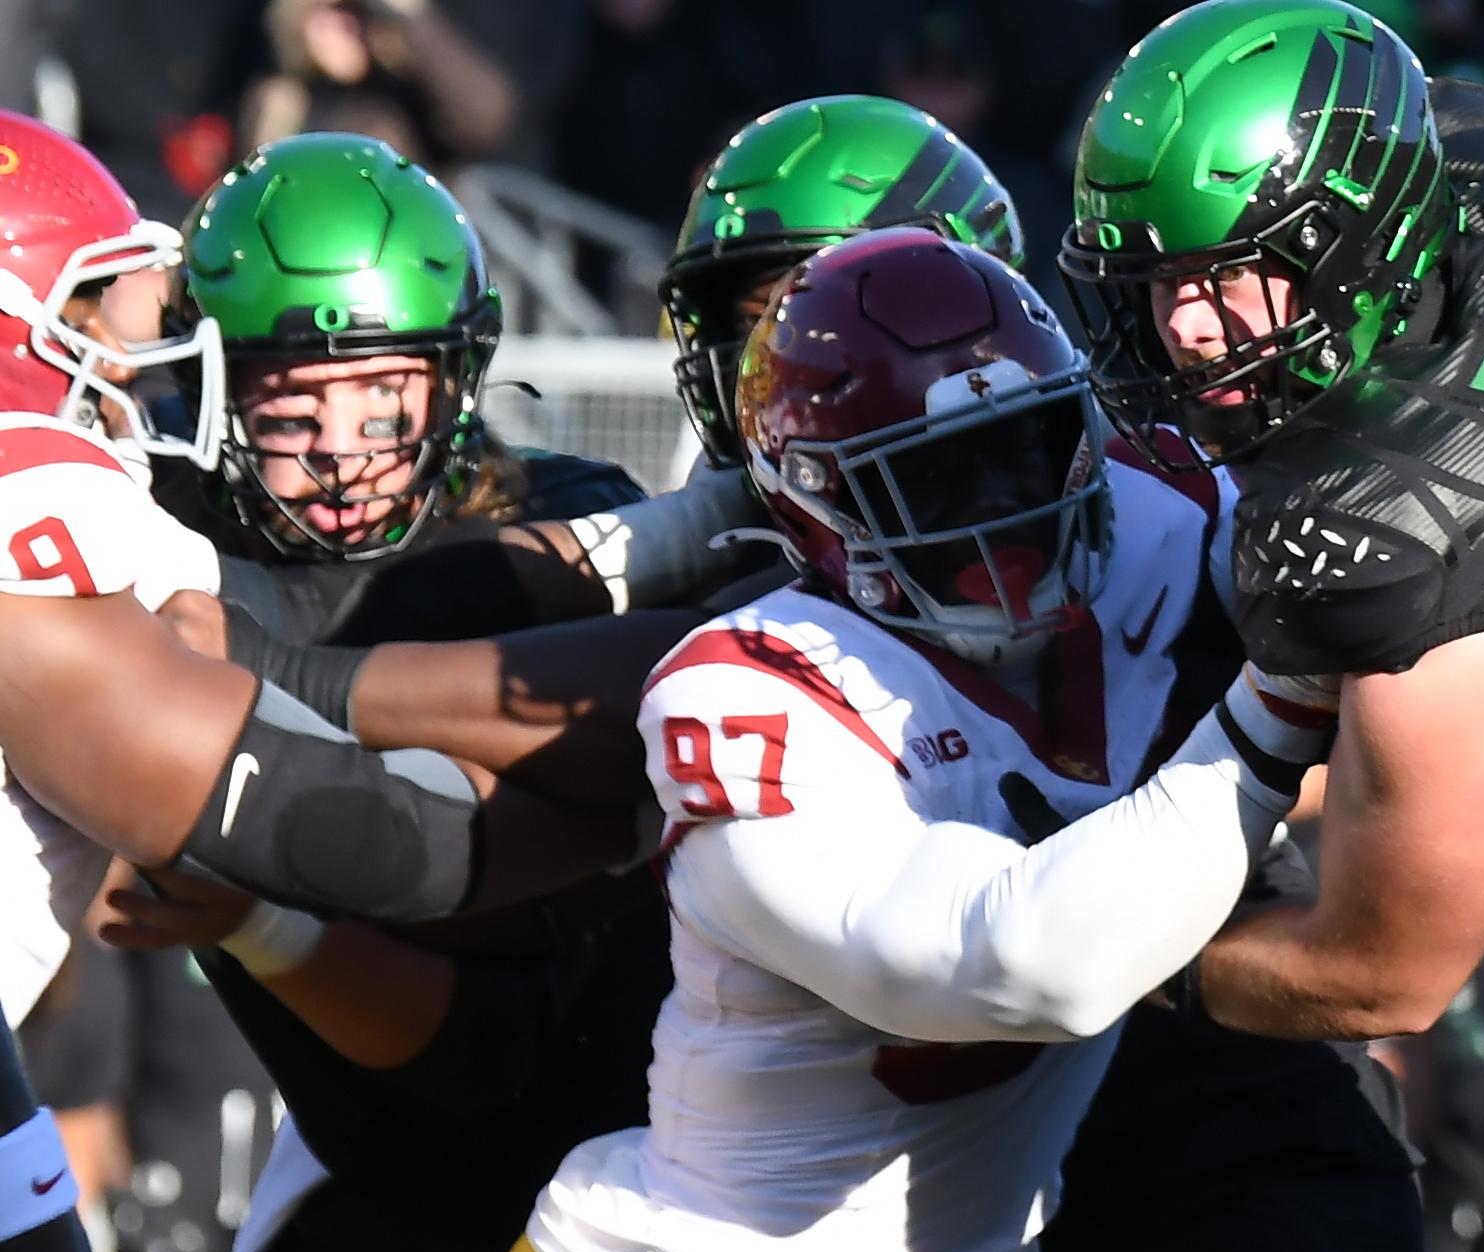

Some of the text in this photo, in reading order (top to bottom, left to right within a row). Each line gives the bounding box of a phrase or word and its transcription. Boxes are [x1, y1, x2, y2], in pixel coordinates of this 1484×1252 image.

[1098, 222, 1122, 251] O
[313, 302, 349, 332] O
[662, 711, 795, 817] 97
